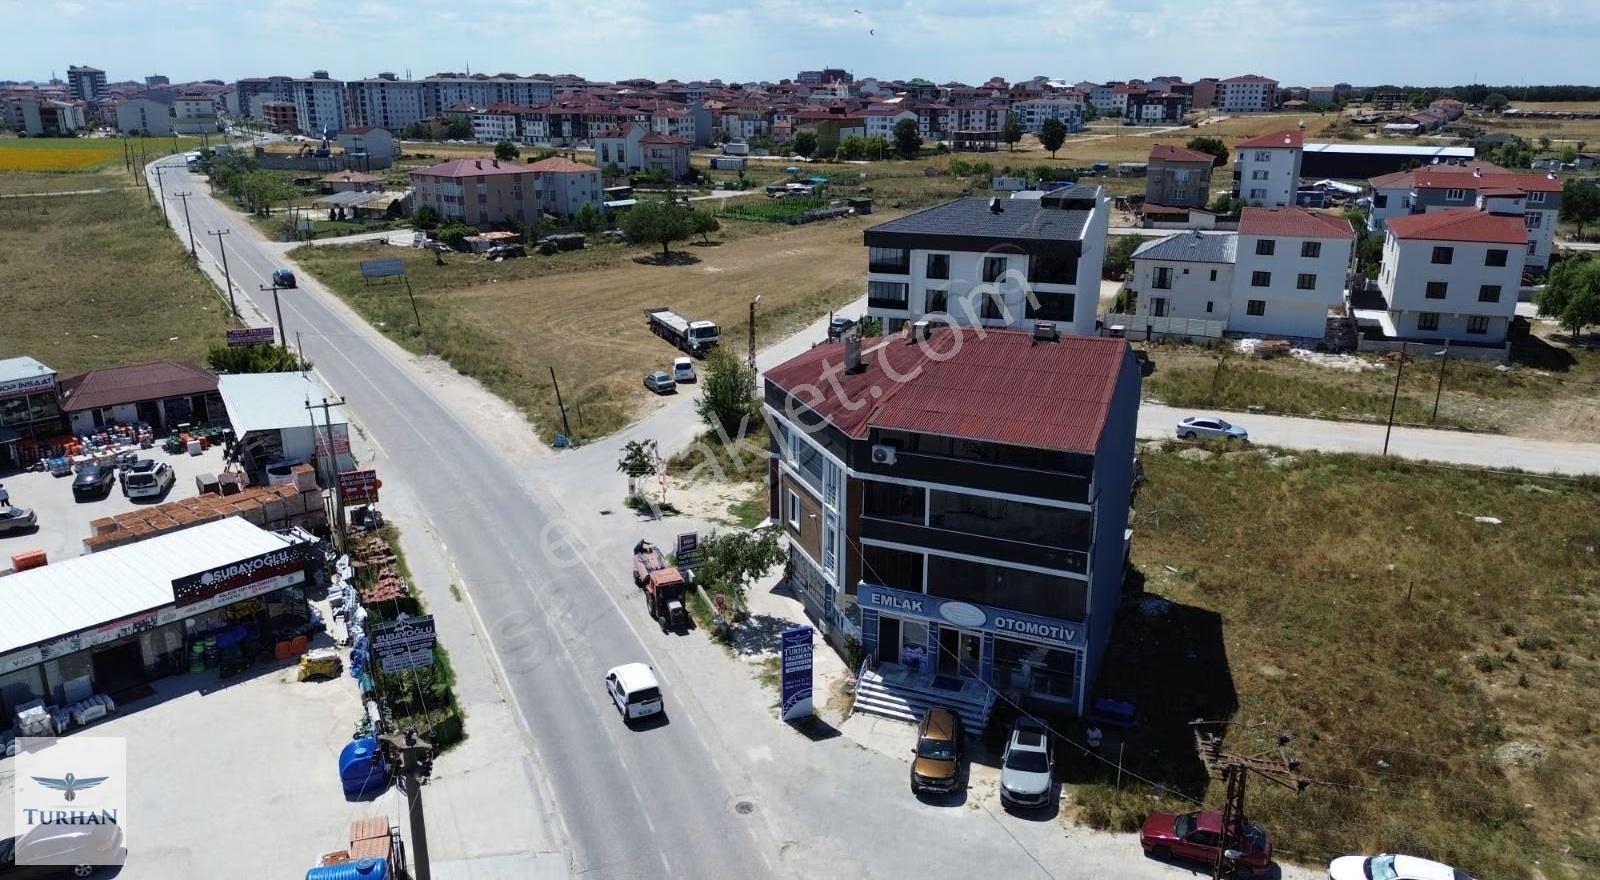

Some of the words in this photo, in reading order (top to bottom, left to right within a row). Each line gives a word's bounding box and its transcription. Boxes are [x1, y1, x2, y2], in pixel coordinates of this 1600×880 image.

[213, 552, 288, 581] SUBAYOĞLU
[871, 592, 923, 612] EMLAK
[376, 626, 433, 642] SUBAYOĞLU
[995, 616, 1076, 641] OTOMOTİV
[784, 645, 812, 657] TURHAN
